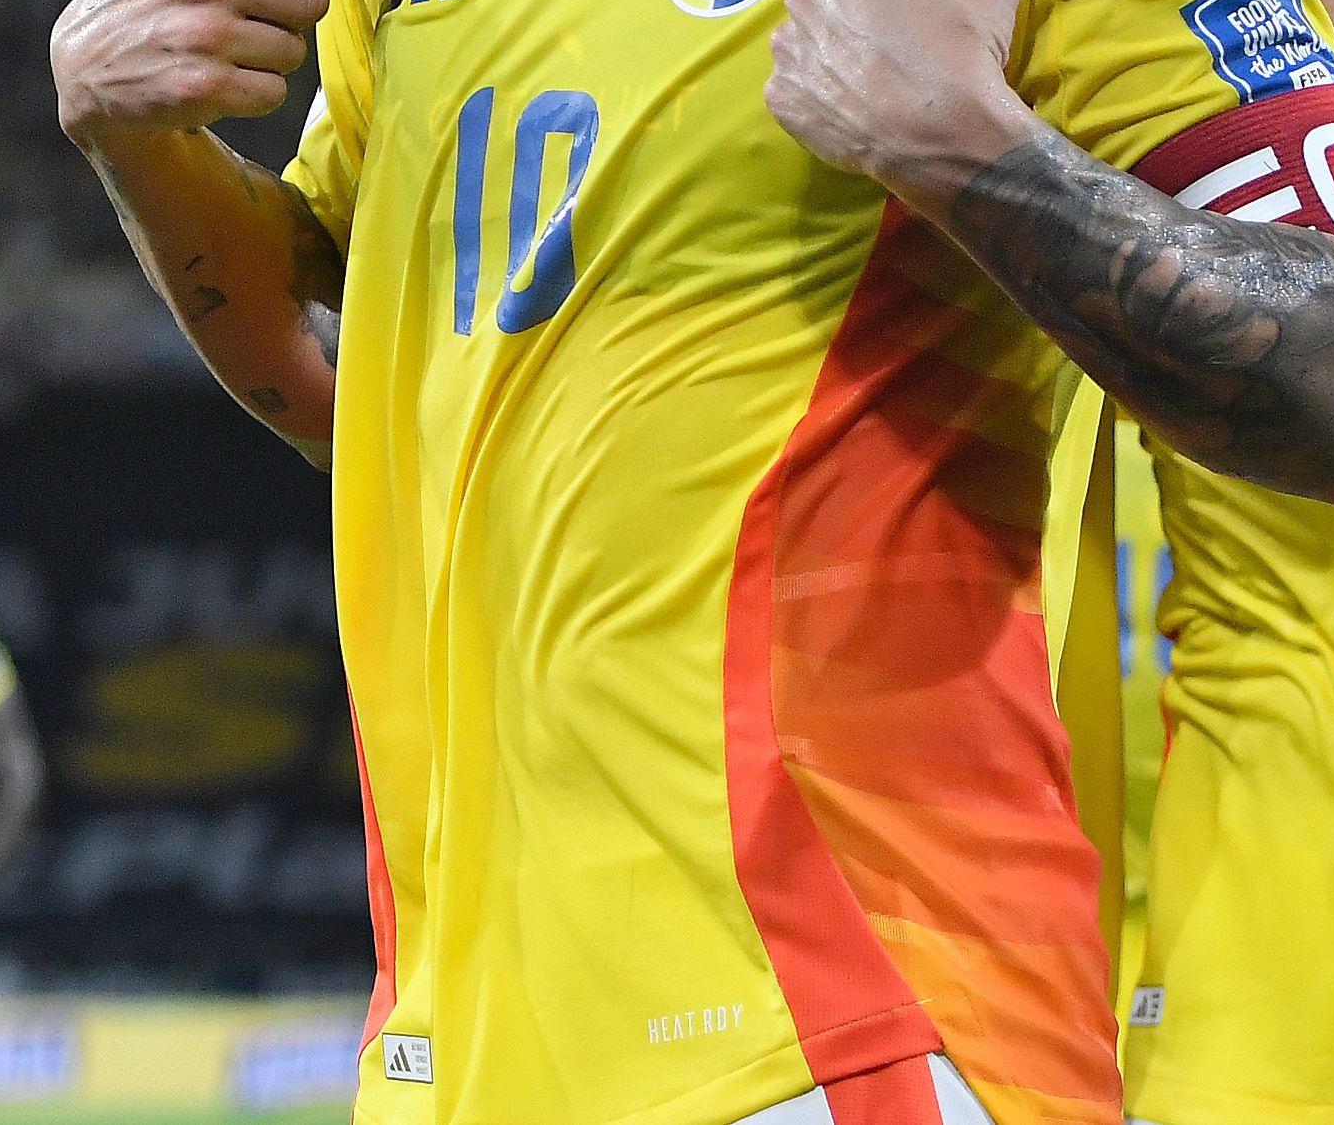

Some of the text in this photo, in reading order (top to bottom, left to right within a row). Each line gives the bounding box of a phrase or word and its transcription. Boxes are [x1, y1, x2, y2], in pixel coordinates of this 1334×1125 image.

[1250, 54, 1285, 78] the
[1299, 67, 1327, 88] FIFA
[453, 85, 600, 337] 10
